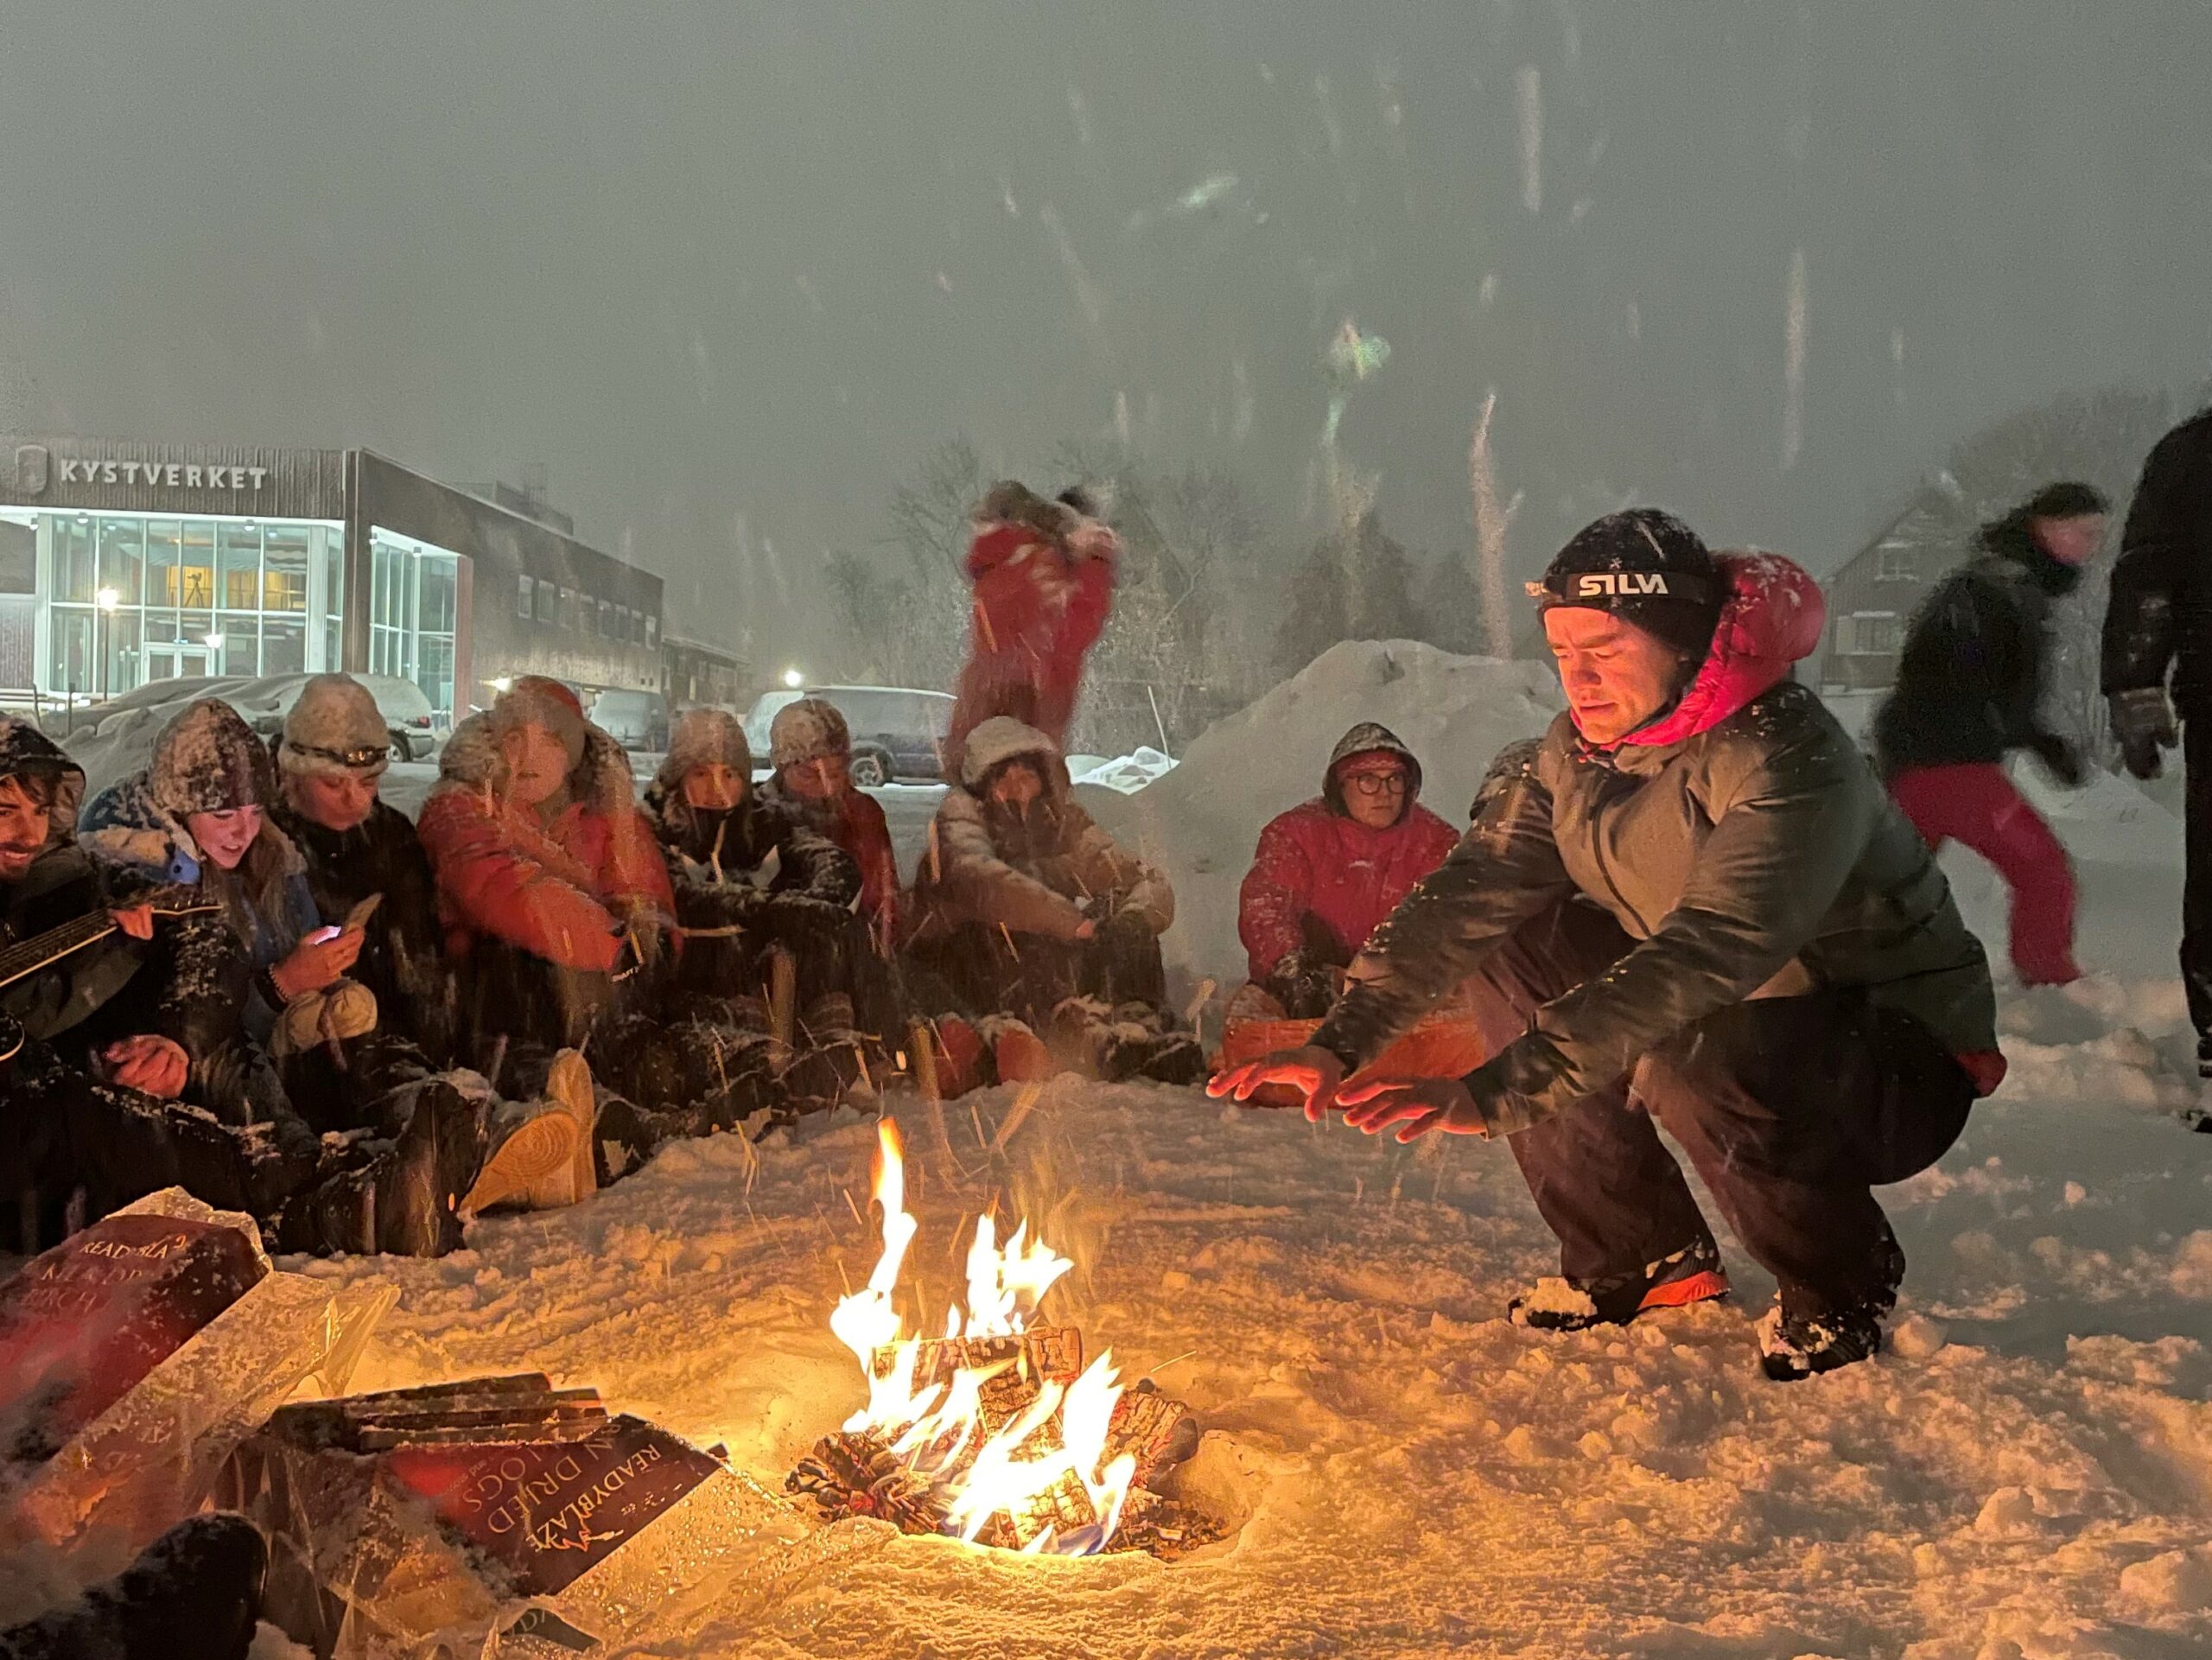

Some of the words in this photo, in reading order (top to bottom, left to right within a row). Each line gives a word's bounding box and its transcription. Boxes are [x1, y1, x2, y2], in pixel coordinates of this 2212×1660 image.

[61, 459, 267, 489] KYSTVERKET
[1580, 574, 1669, 596] SILVA
[487, 1454, 582, 1534] DRIED
[525, 1443, 661, 1553] READYBLAZE
